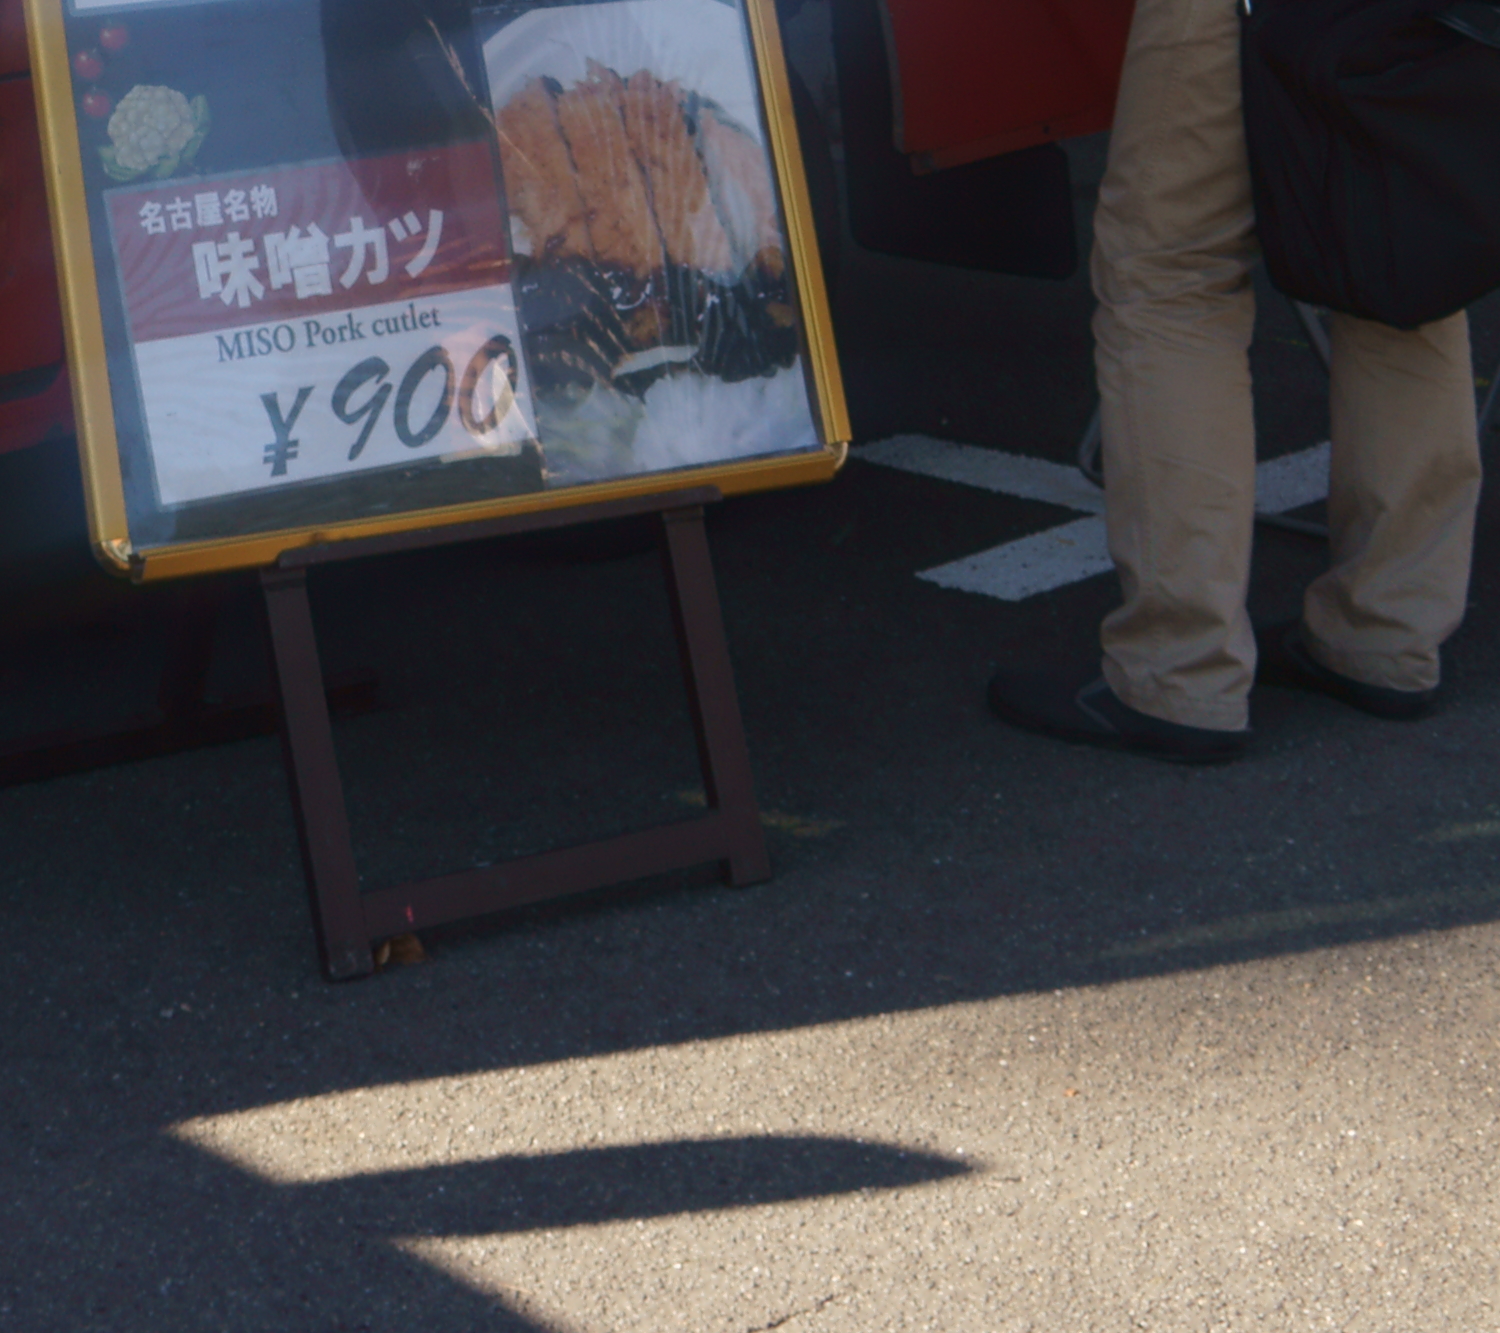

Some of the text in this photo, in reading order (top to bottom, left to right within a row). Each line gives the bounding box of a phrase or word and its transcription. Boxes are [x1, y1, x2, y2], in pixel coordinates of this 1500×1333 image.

[139, 185, 278, 235] 名古屋名物
[192, 208, 444, 310] 味噌カツ
[217, 304, 441, 363] MISO Pork cutlet
[260, 335, 517, 476] ¥900
